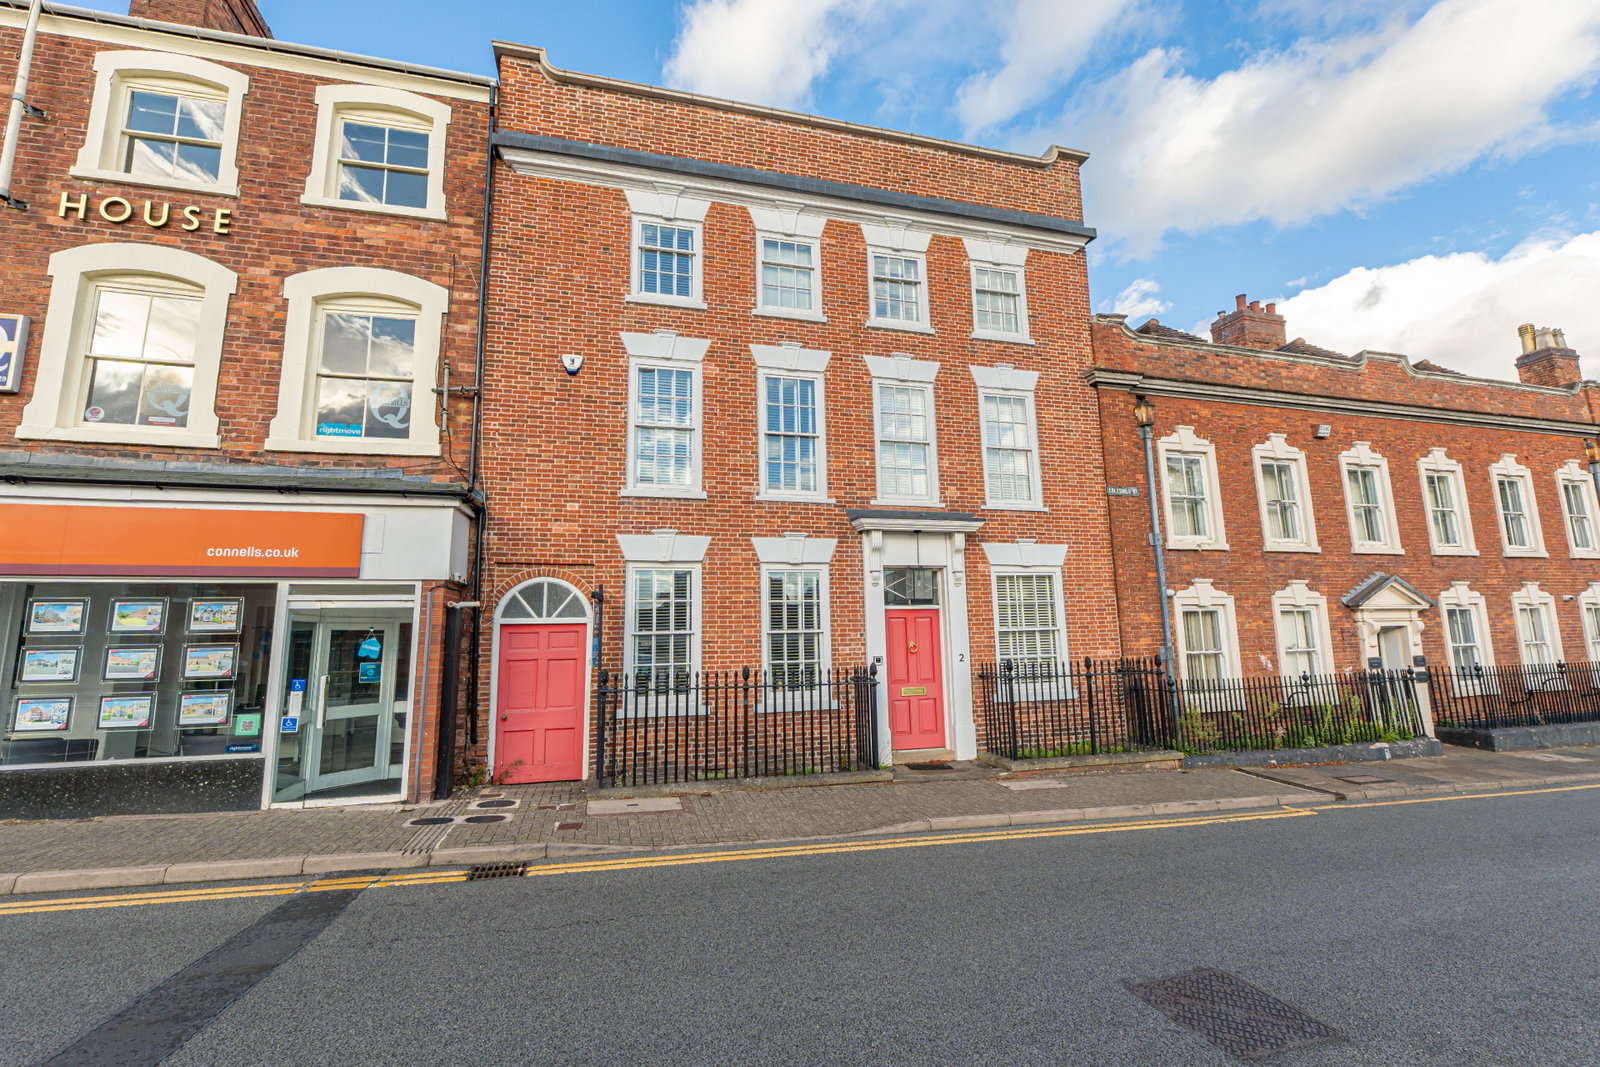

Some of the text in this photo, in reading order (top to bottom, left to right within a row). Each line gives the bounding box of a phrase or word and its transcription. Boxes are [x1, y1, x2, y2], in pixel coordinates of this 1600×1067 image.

[58, 191, 232, 235] HOUSE
[318, 425, 361, 435] rightmove
[206, 546, 299, 558] connells.co.uk
[958, 653, 965, 662] 2
